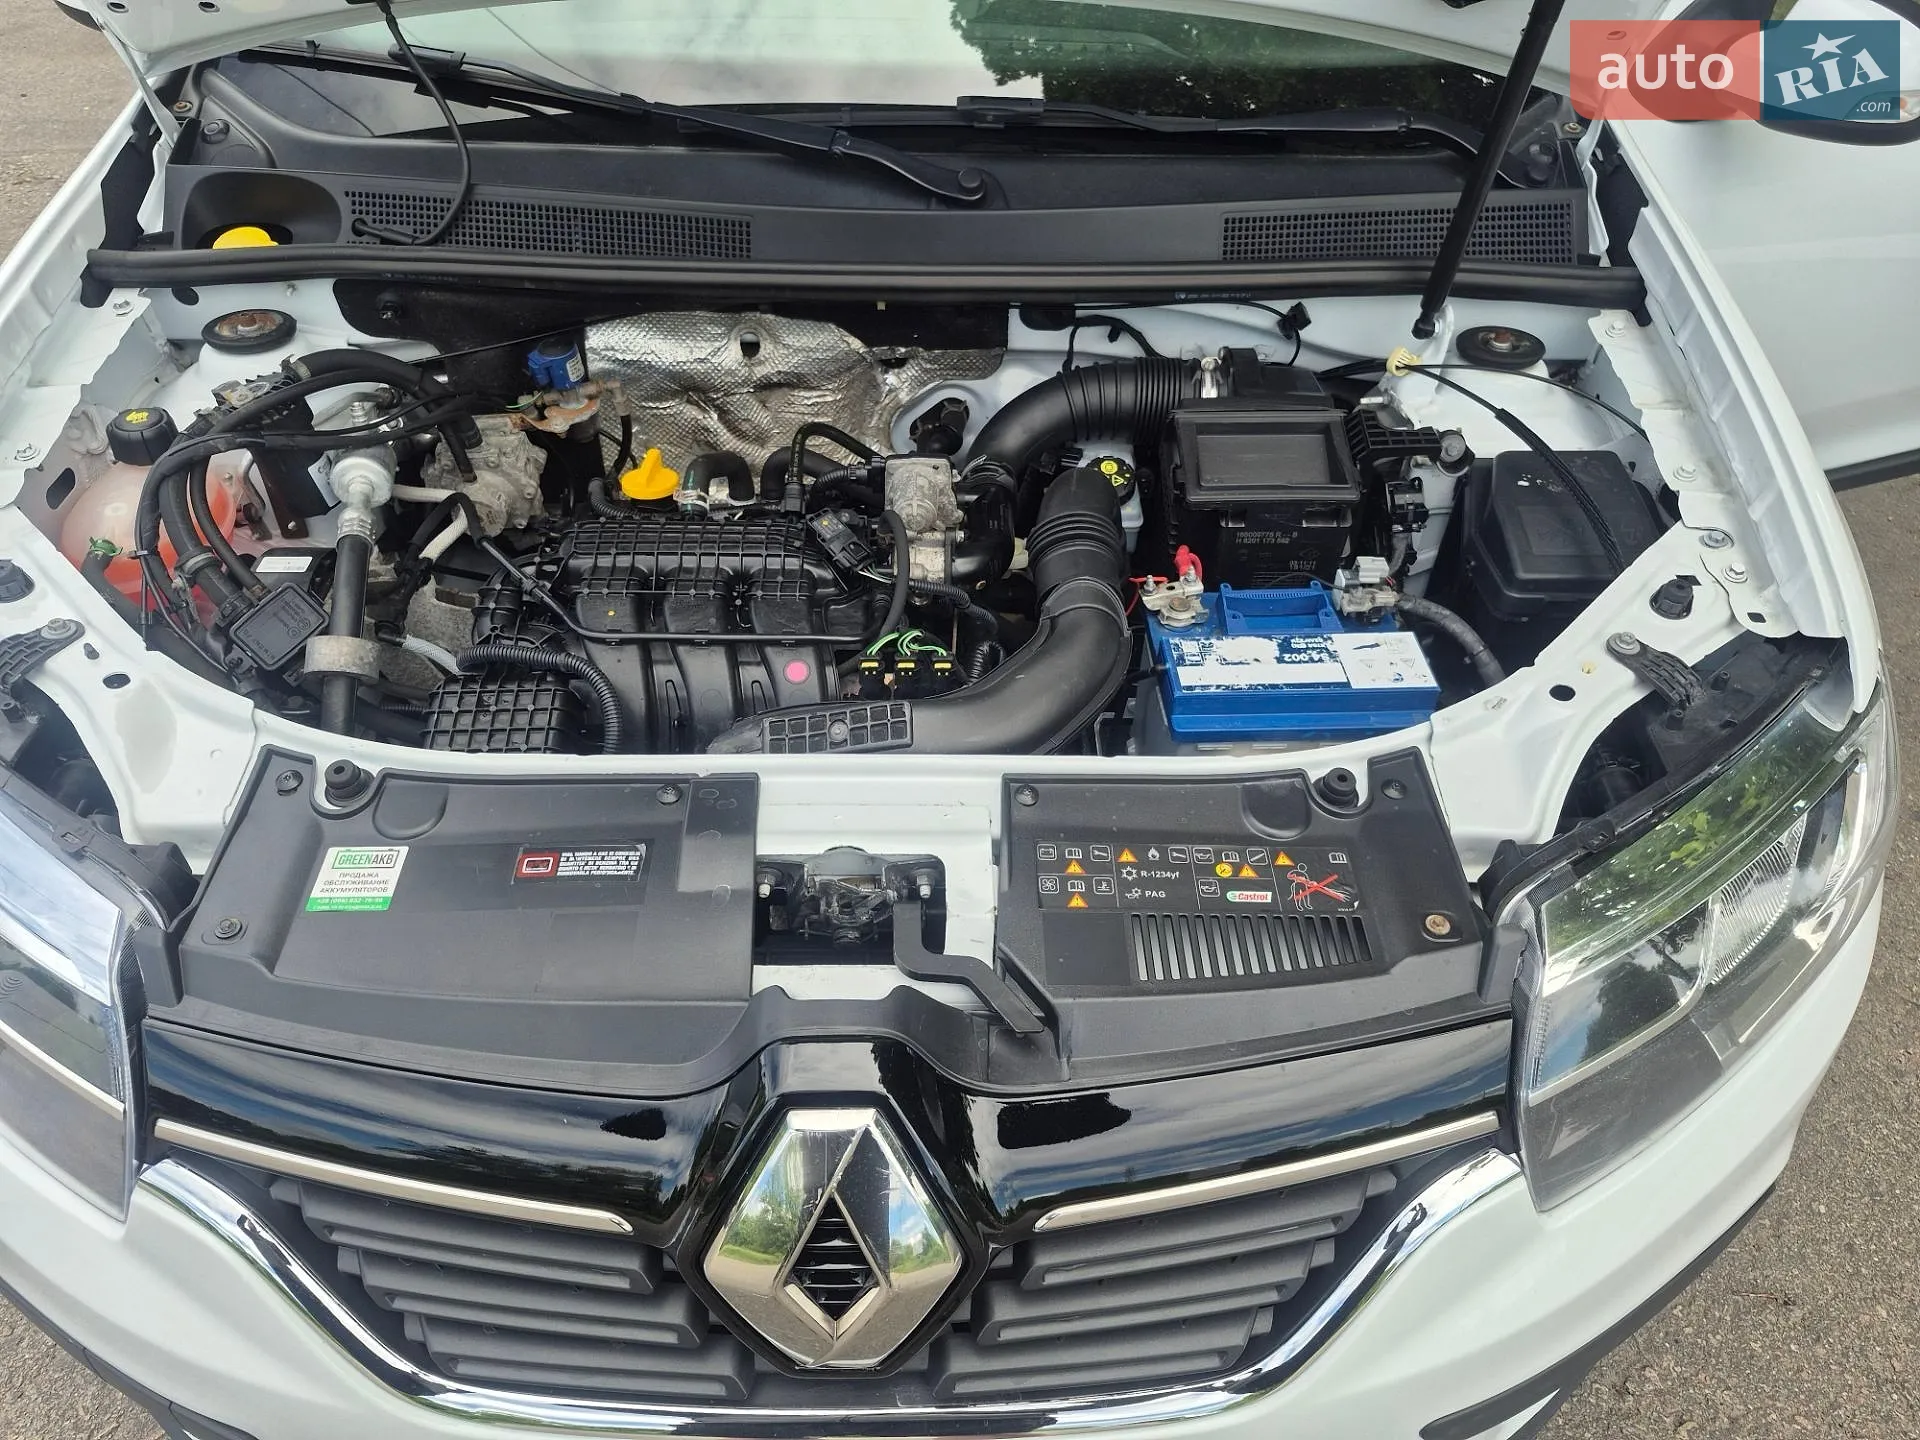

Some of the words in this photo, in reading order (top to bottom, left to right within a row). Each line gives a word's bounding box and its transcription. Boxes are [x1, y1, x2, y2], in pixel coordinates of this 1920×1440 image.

[338, 854, 394, 865] GREENAKB
[1140, 871, 1180, 880] R-1234yf
[1145, 890, 1166, 898] PAG
[1237, 892, 1269, 901] Castrol
